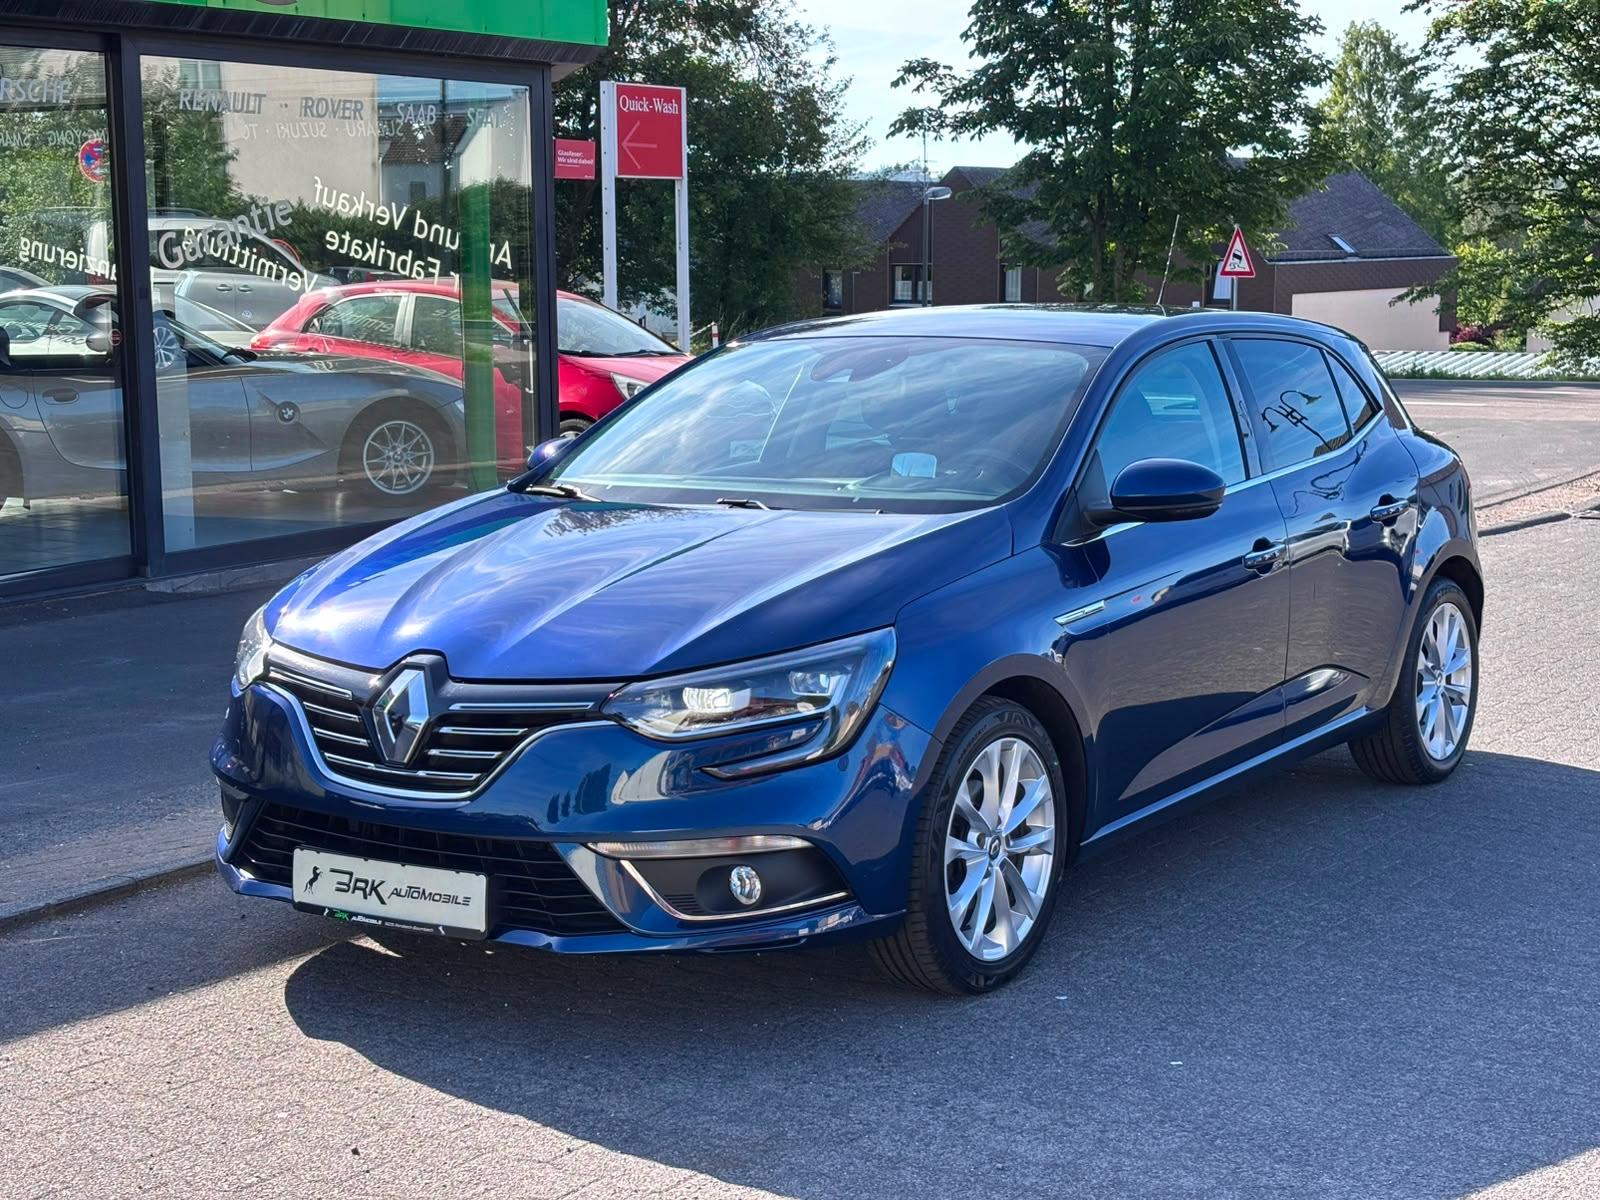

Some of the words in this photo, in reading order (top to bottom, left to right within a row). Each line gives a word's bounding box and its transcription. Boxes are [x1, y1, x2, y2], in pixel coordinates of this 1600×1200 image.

[178, 89, 266, 114] RENAULT
[300, 96, 363, 120] ROVER
[397, 103, 436, 125] SAAB
[620, 95, 679, 114] Quick-Wash
[158, 197, 294, 269] Garantie
[329, 868, 387, 905] BRK
[387, 885, 471, 906] AUTOMOBILE
